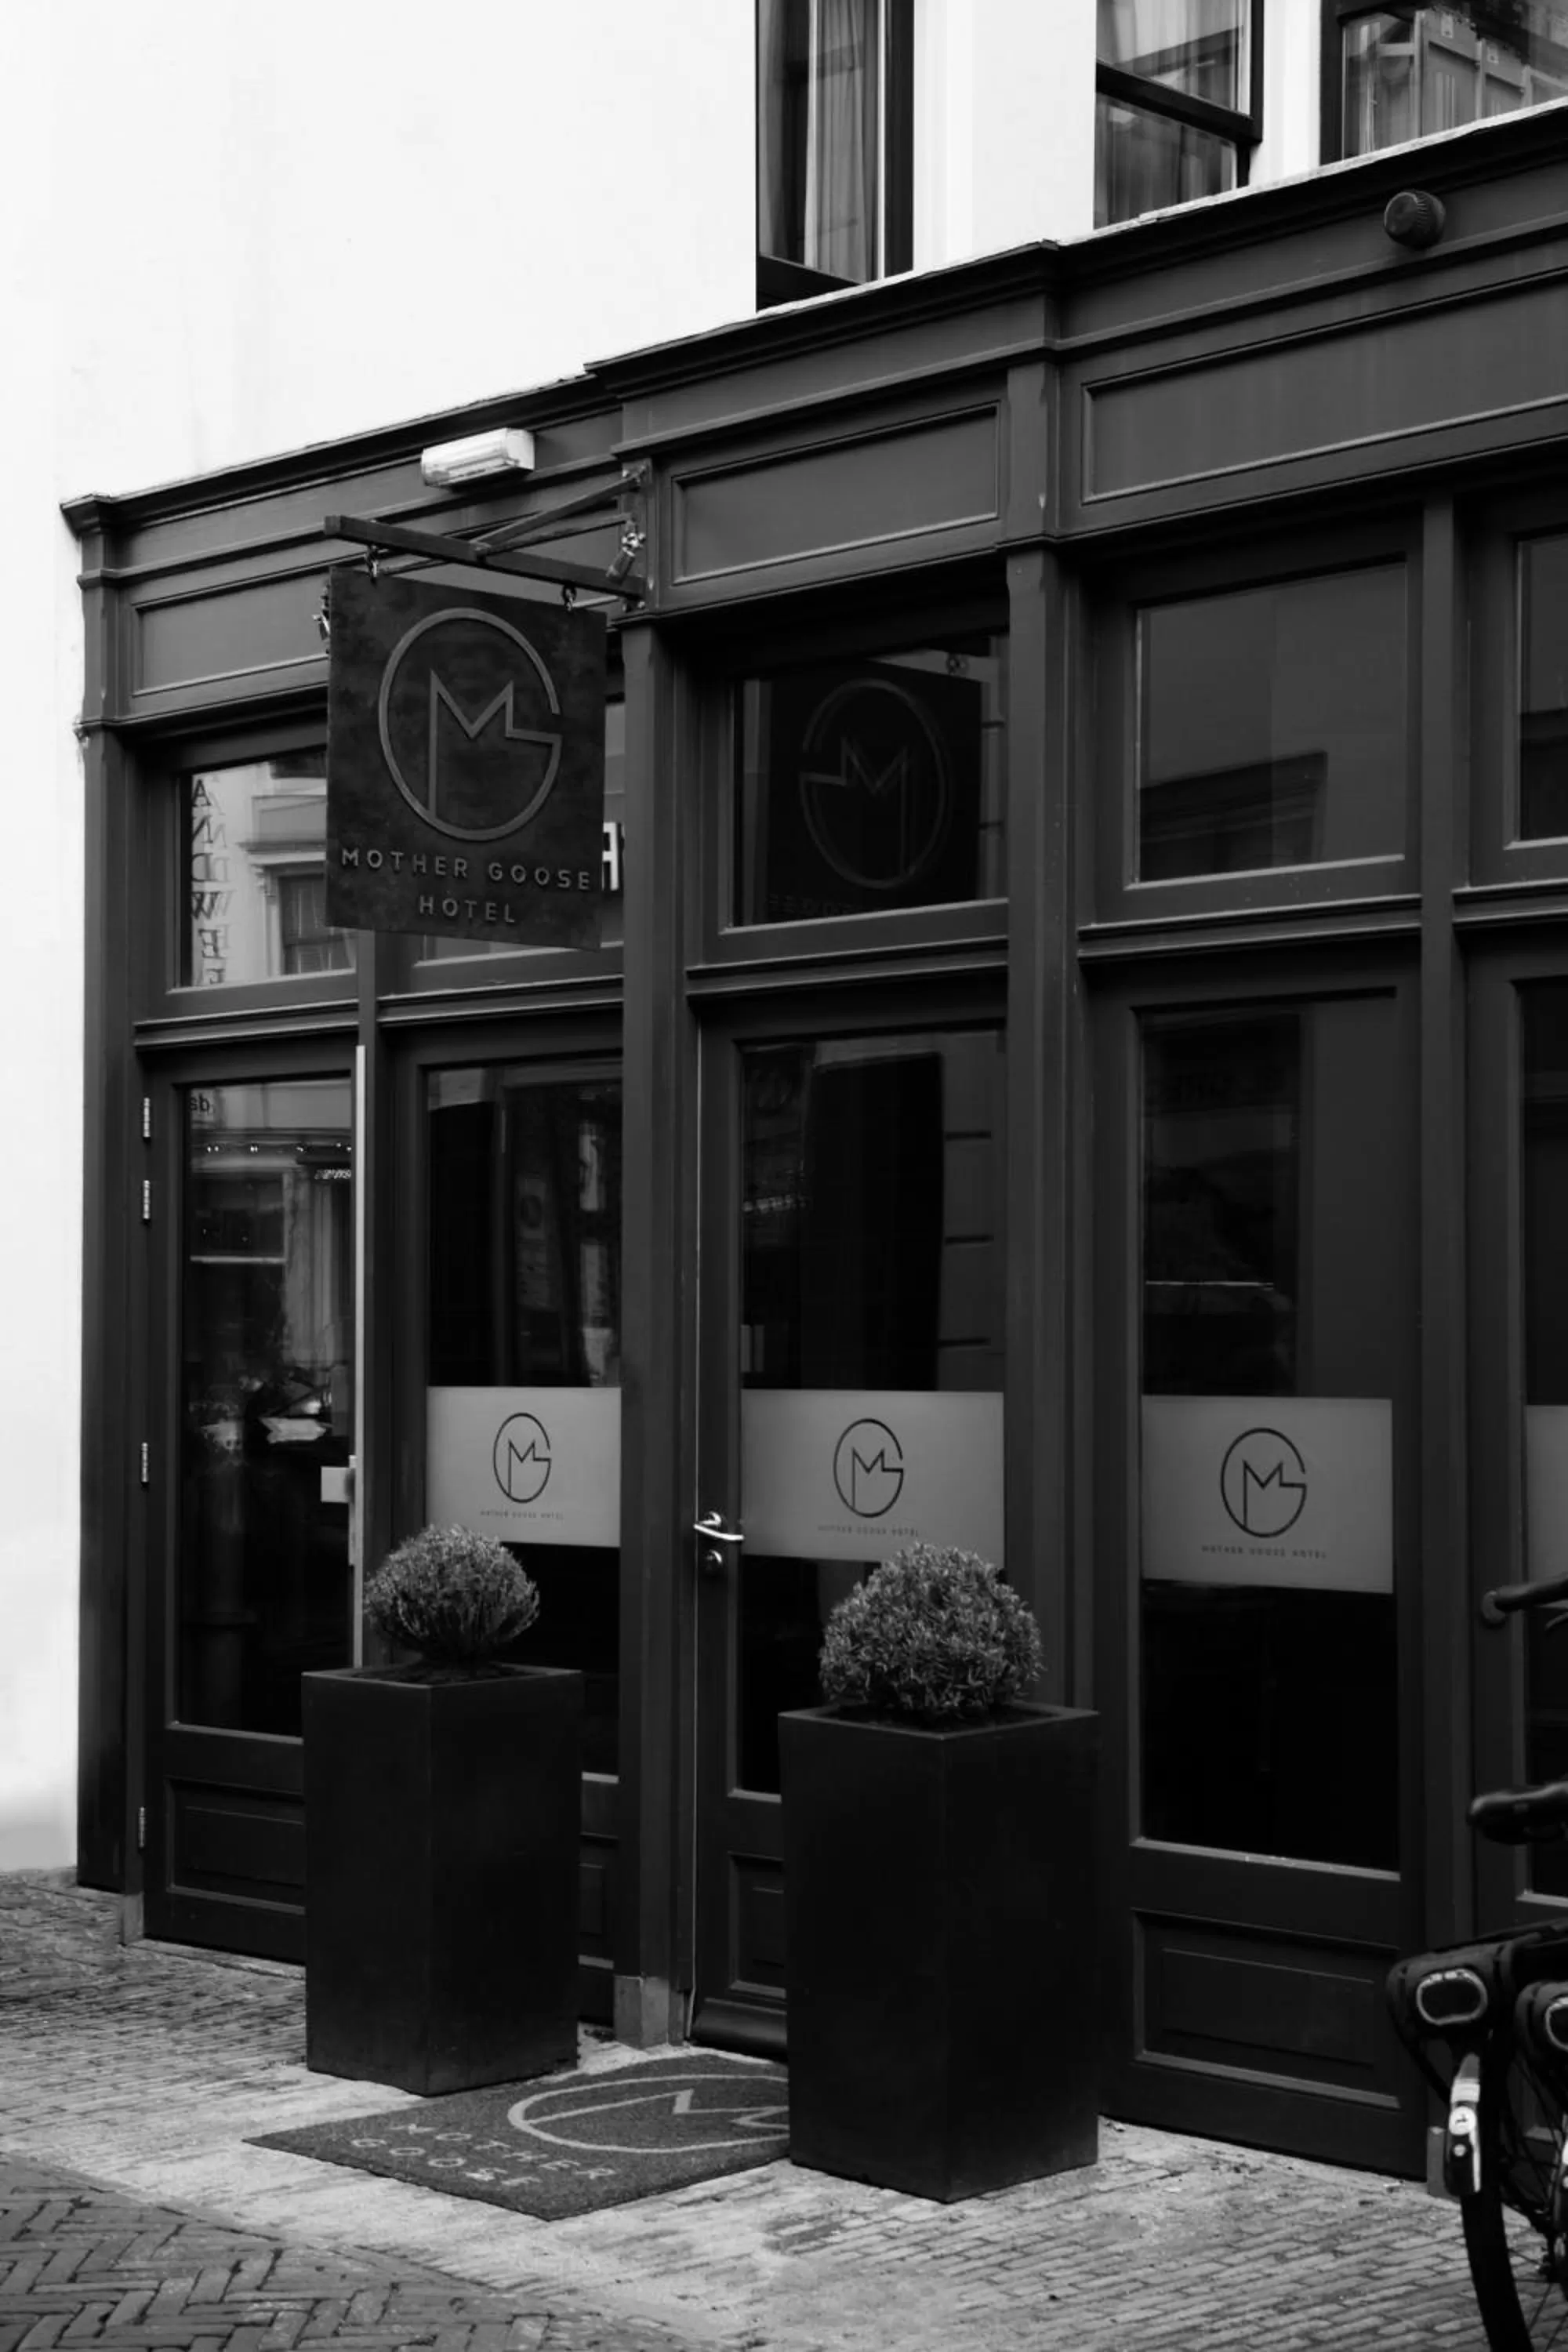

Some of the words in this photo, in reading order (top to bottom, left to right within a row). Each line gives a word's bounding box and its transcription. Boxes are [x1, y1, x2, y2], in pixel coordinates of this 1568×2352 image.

[342, 848, 468, 878] MOTHER
[488, 862, 590, 890] GOOSE
[419, 895, 514, 923] HOTEL
